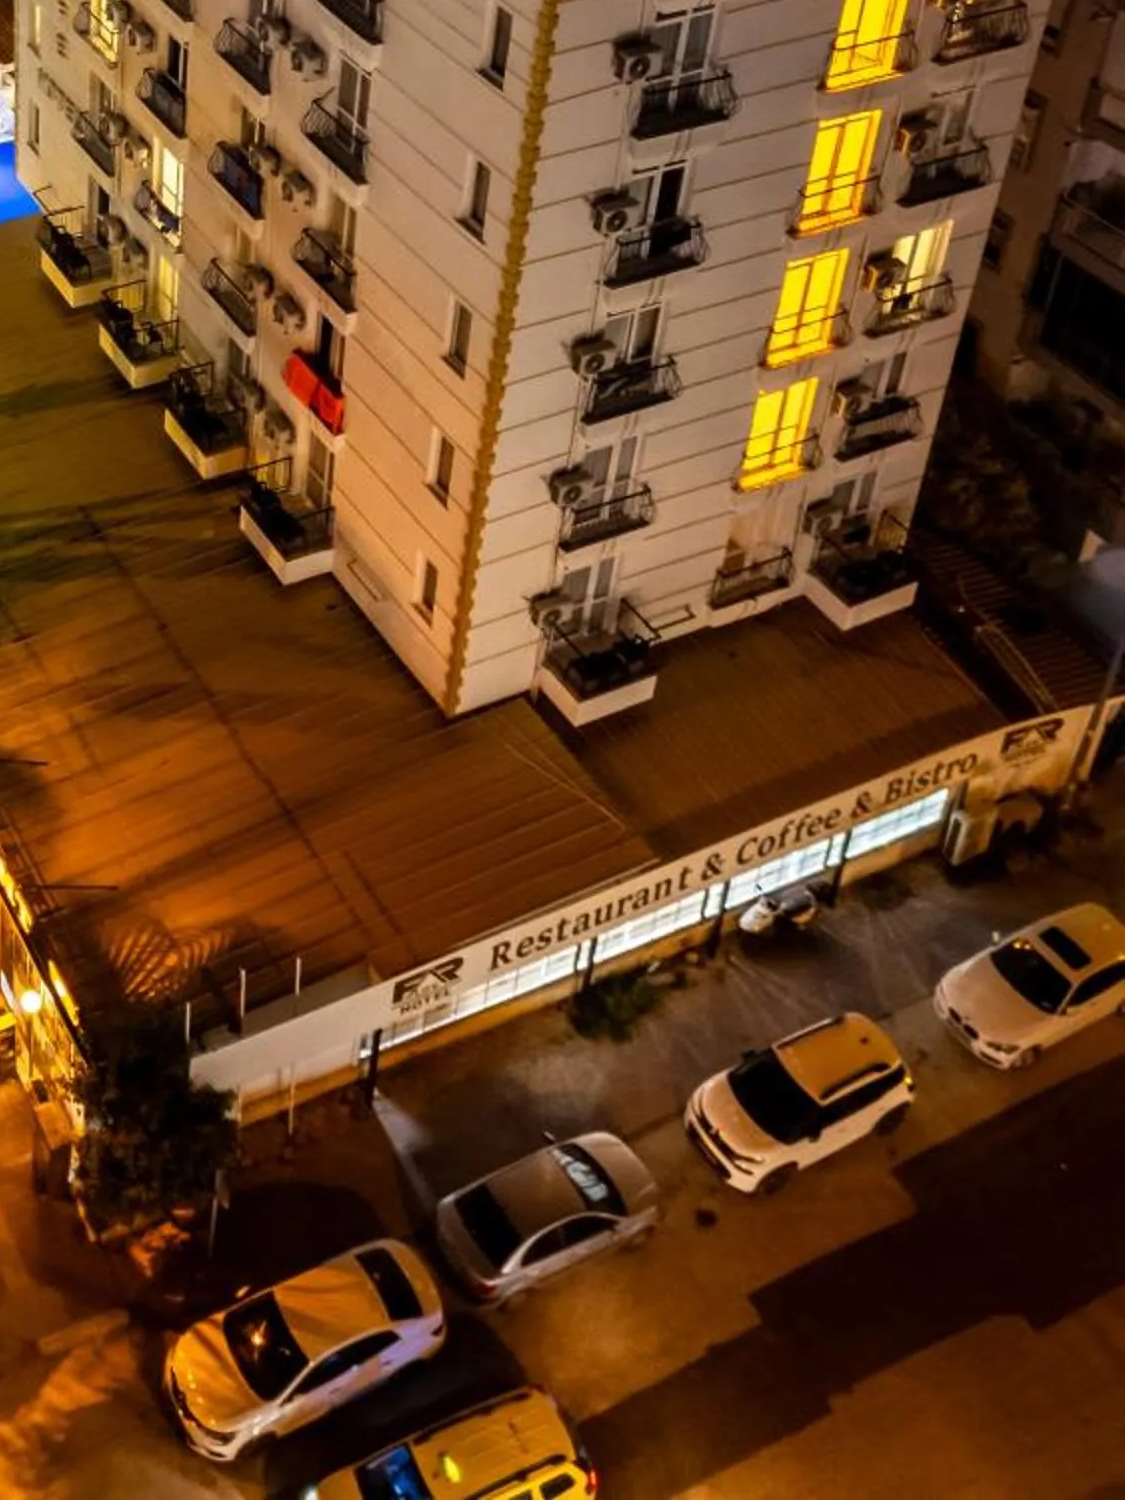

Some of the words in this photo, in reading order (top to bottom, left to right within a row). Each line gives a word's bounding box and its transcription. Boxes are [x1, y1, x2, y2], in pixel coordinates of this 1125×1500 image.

[487, 864, 695, 971] Restaurant
[701, 852, 725, 882] &
[736, 807, 842, 866] Coffee
[849, 790, 872, 821] &
[883, 753, 978, 806] Bistro
